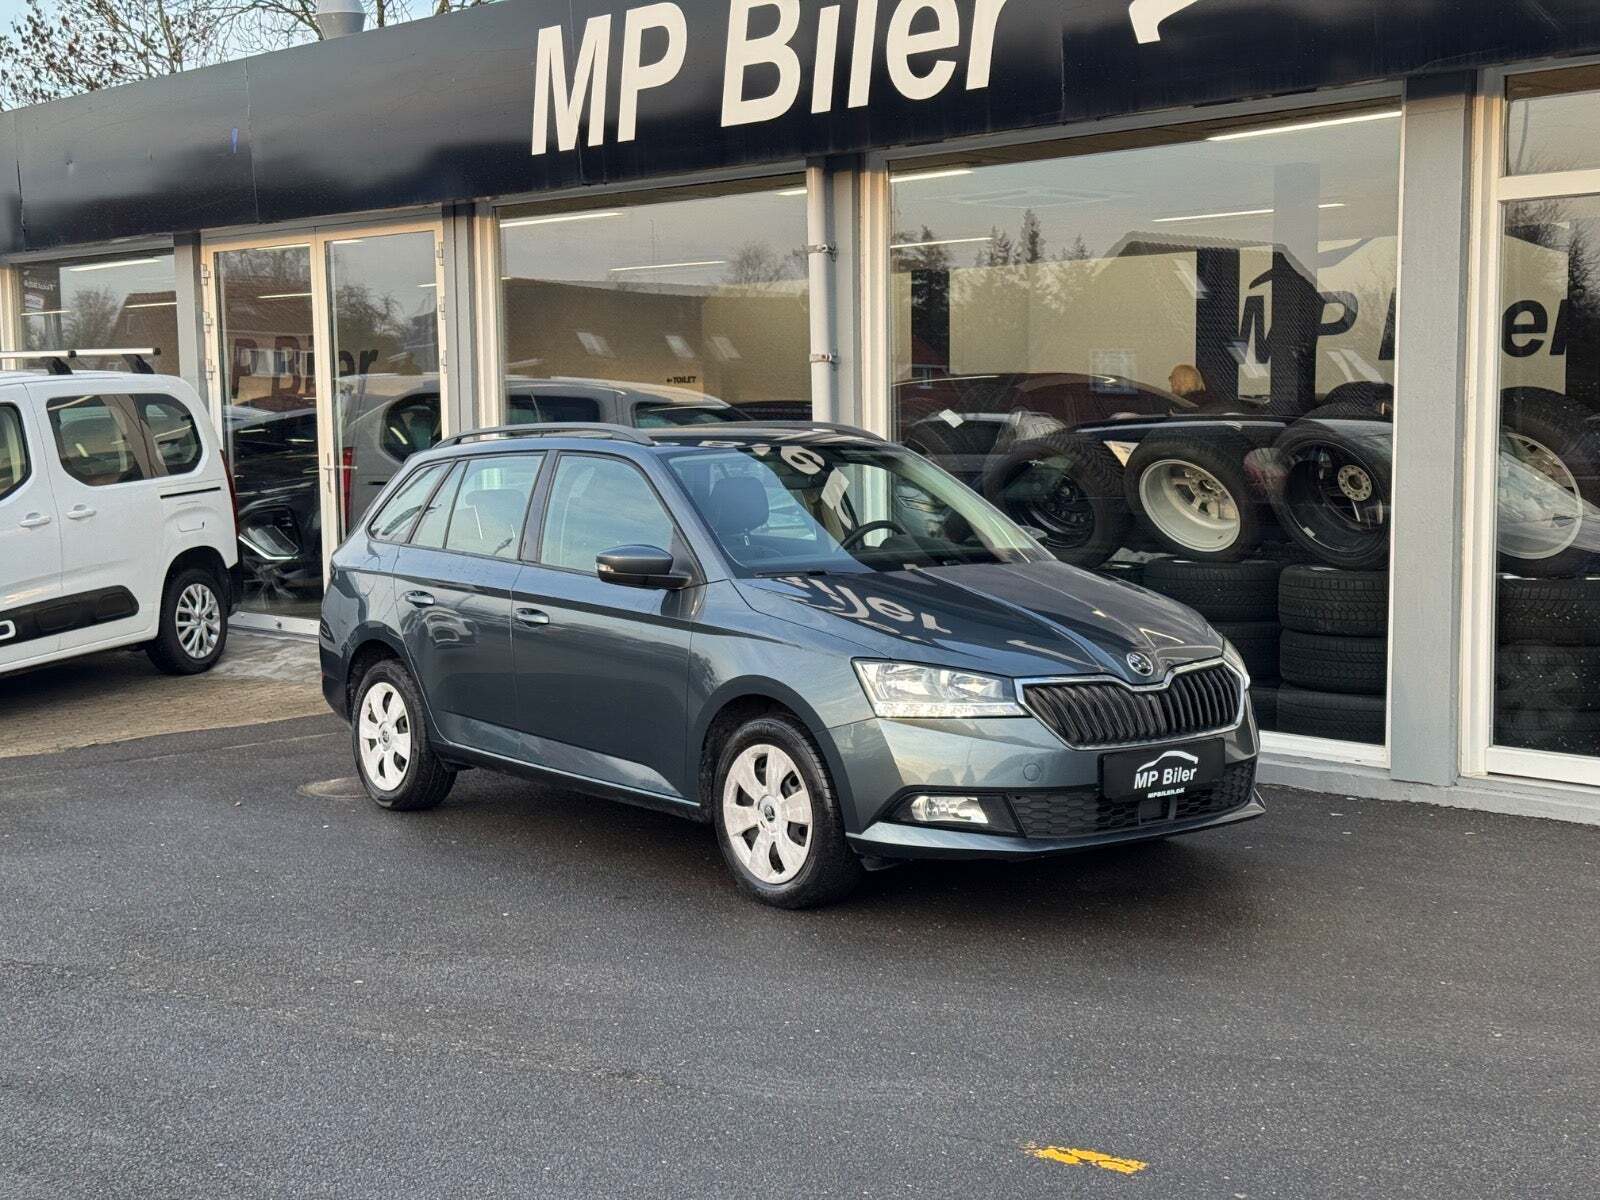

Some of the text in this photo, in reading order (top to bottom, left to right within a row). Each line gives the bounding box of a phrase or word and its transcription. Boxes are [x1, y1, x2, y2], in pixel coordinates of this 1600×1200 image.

[531, 0, 1007, 156] MP Biler
[1134, 766, 1198, 790] MP Biler
